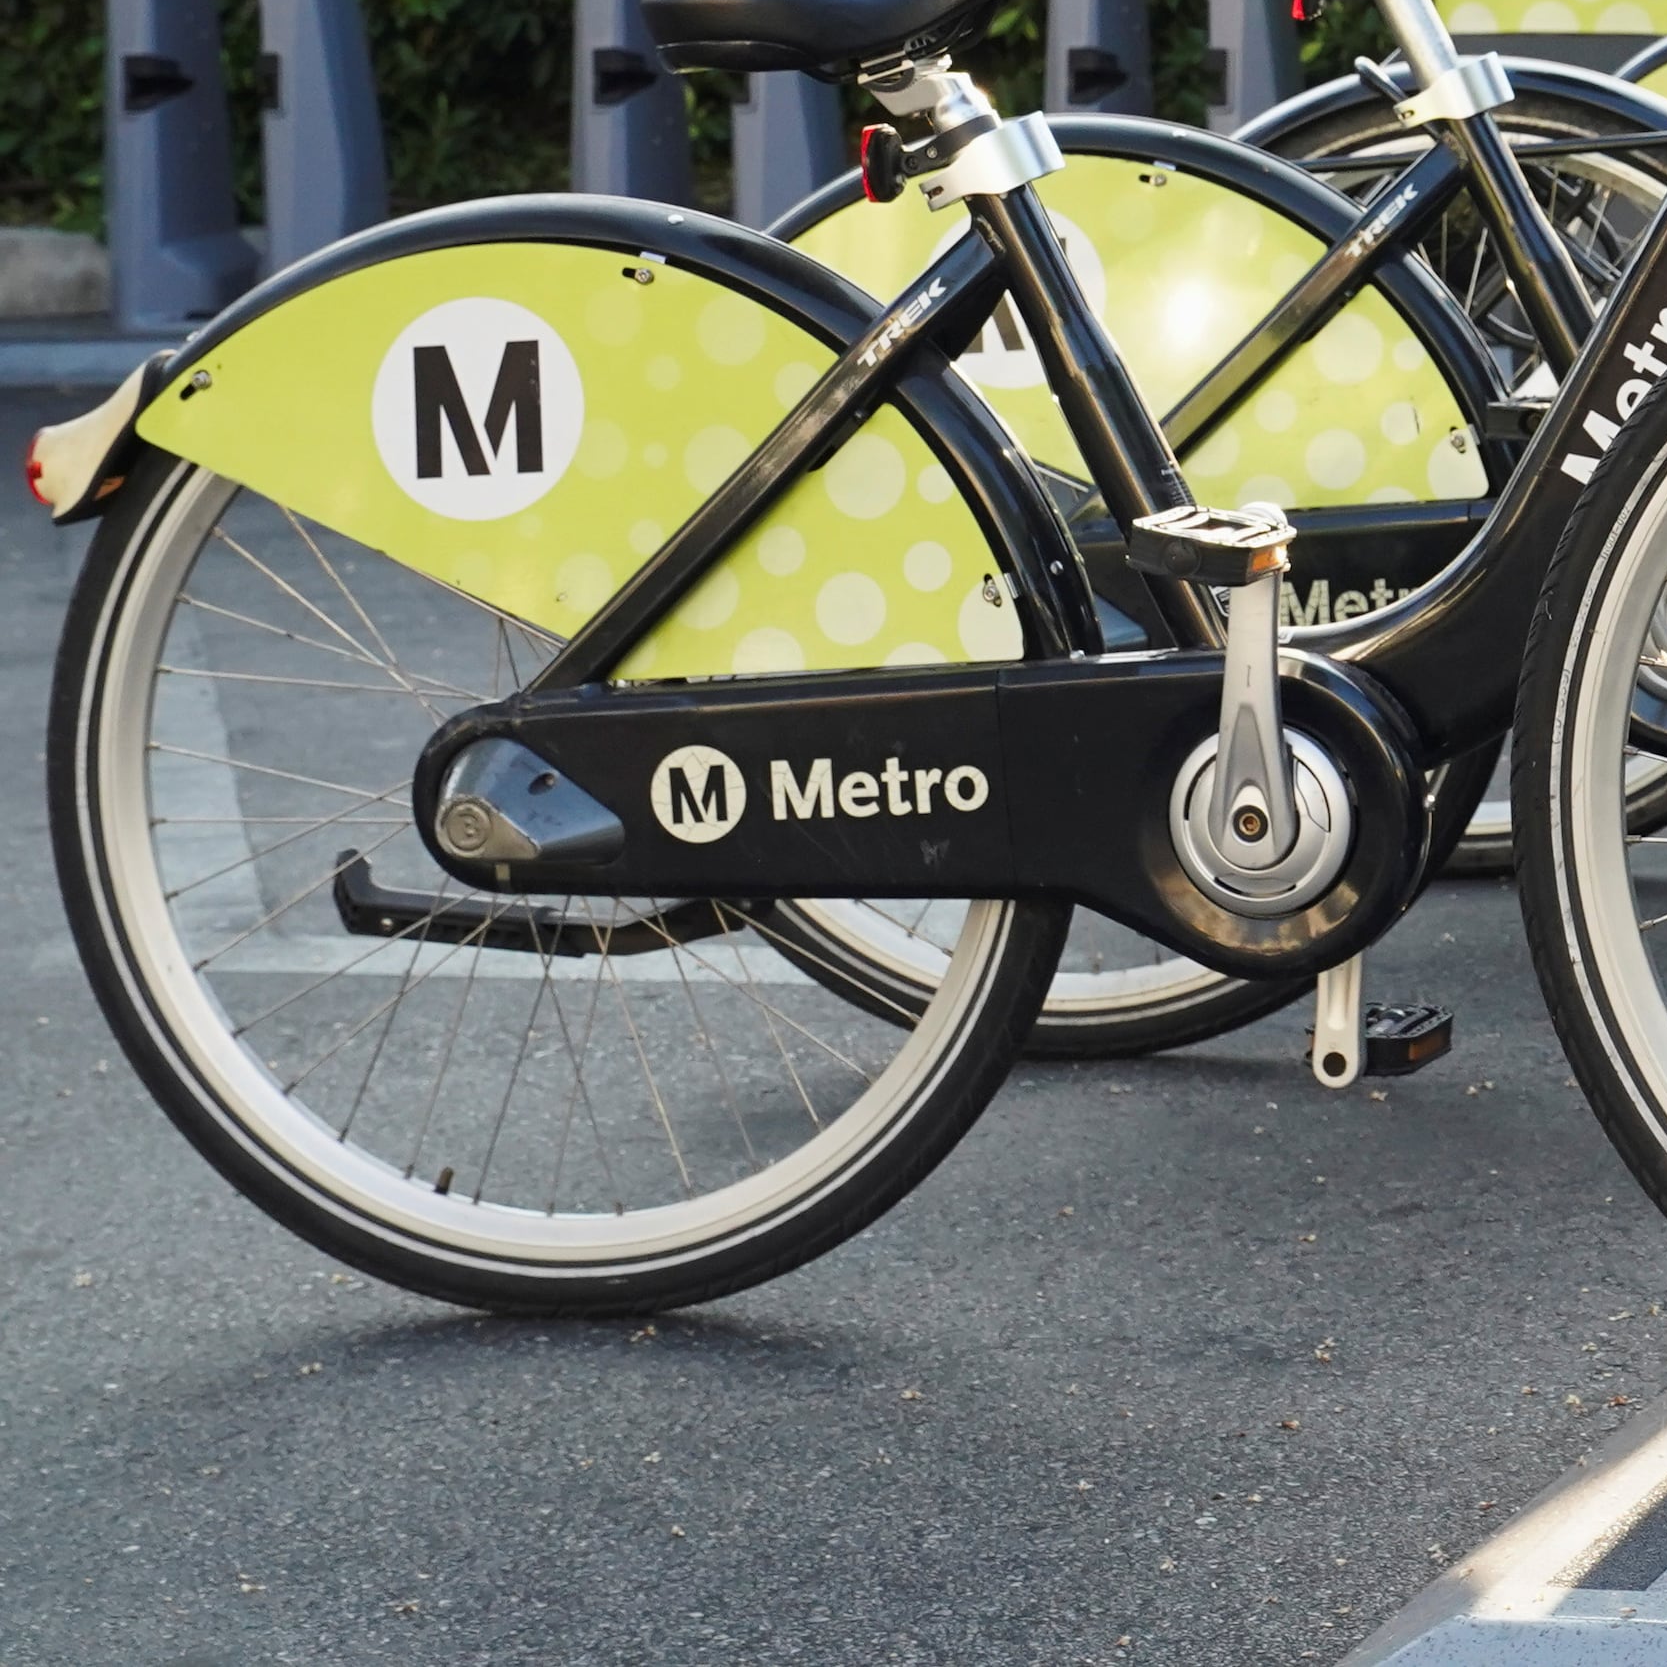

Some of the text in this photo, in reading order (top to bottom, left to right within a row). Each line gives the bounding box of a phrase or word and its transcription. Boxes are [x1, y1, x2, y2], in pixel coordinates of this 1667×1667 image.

[1345, 183, 1419, 259] TREK
[857, 277, 949, 368] TREK
[412, 340, 544, 479] M
[1279, 578, 1419, 627] Met
[668, 755, 990, 825] M Metro
